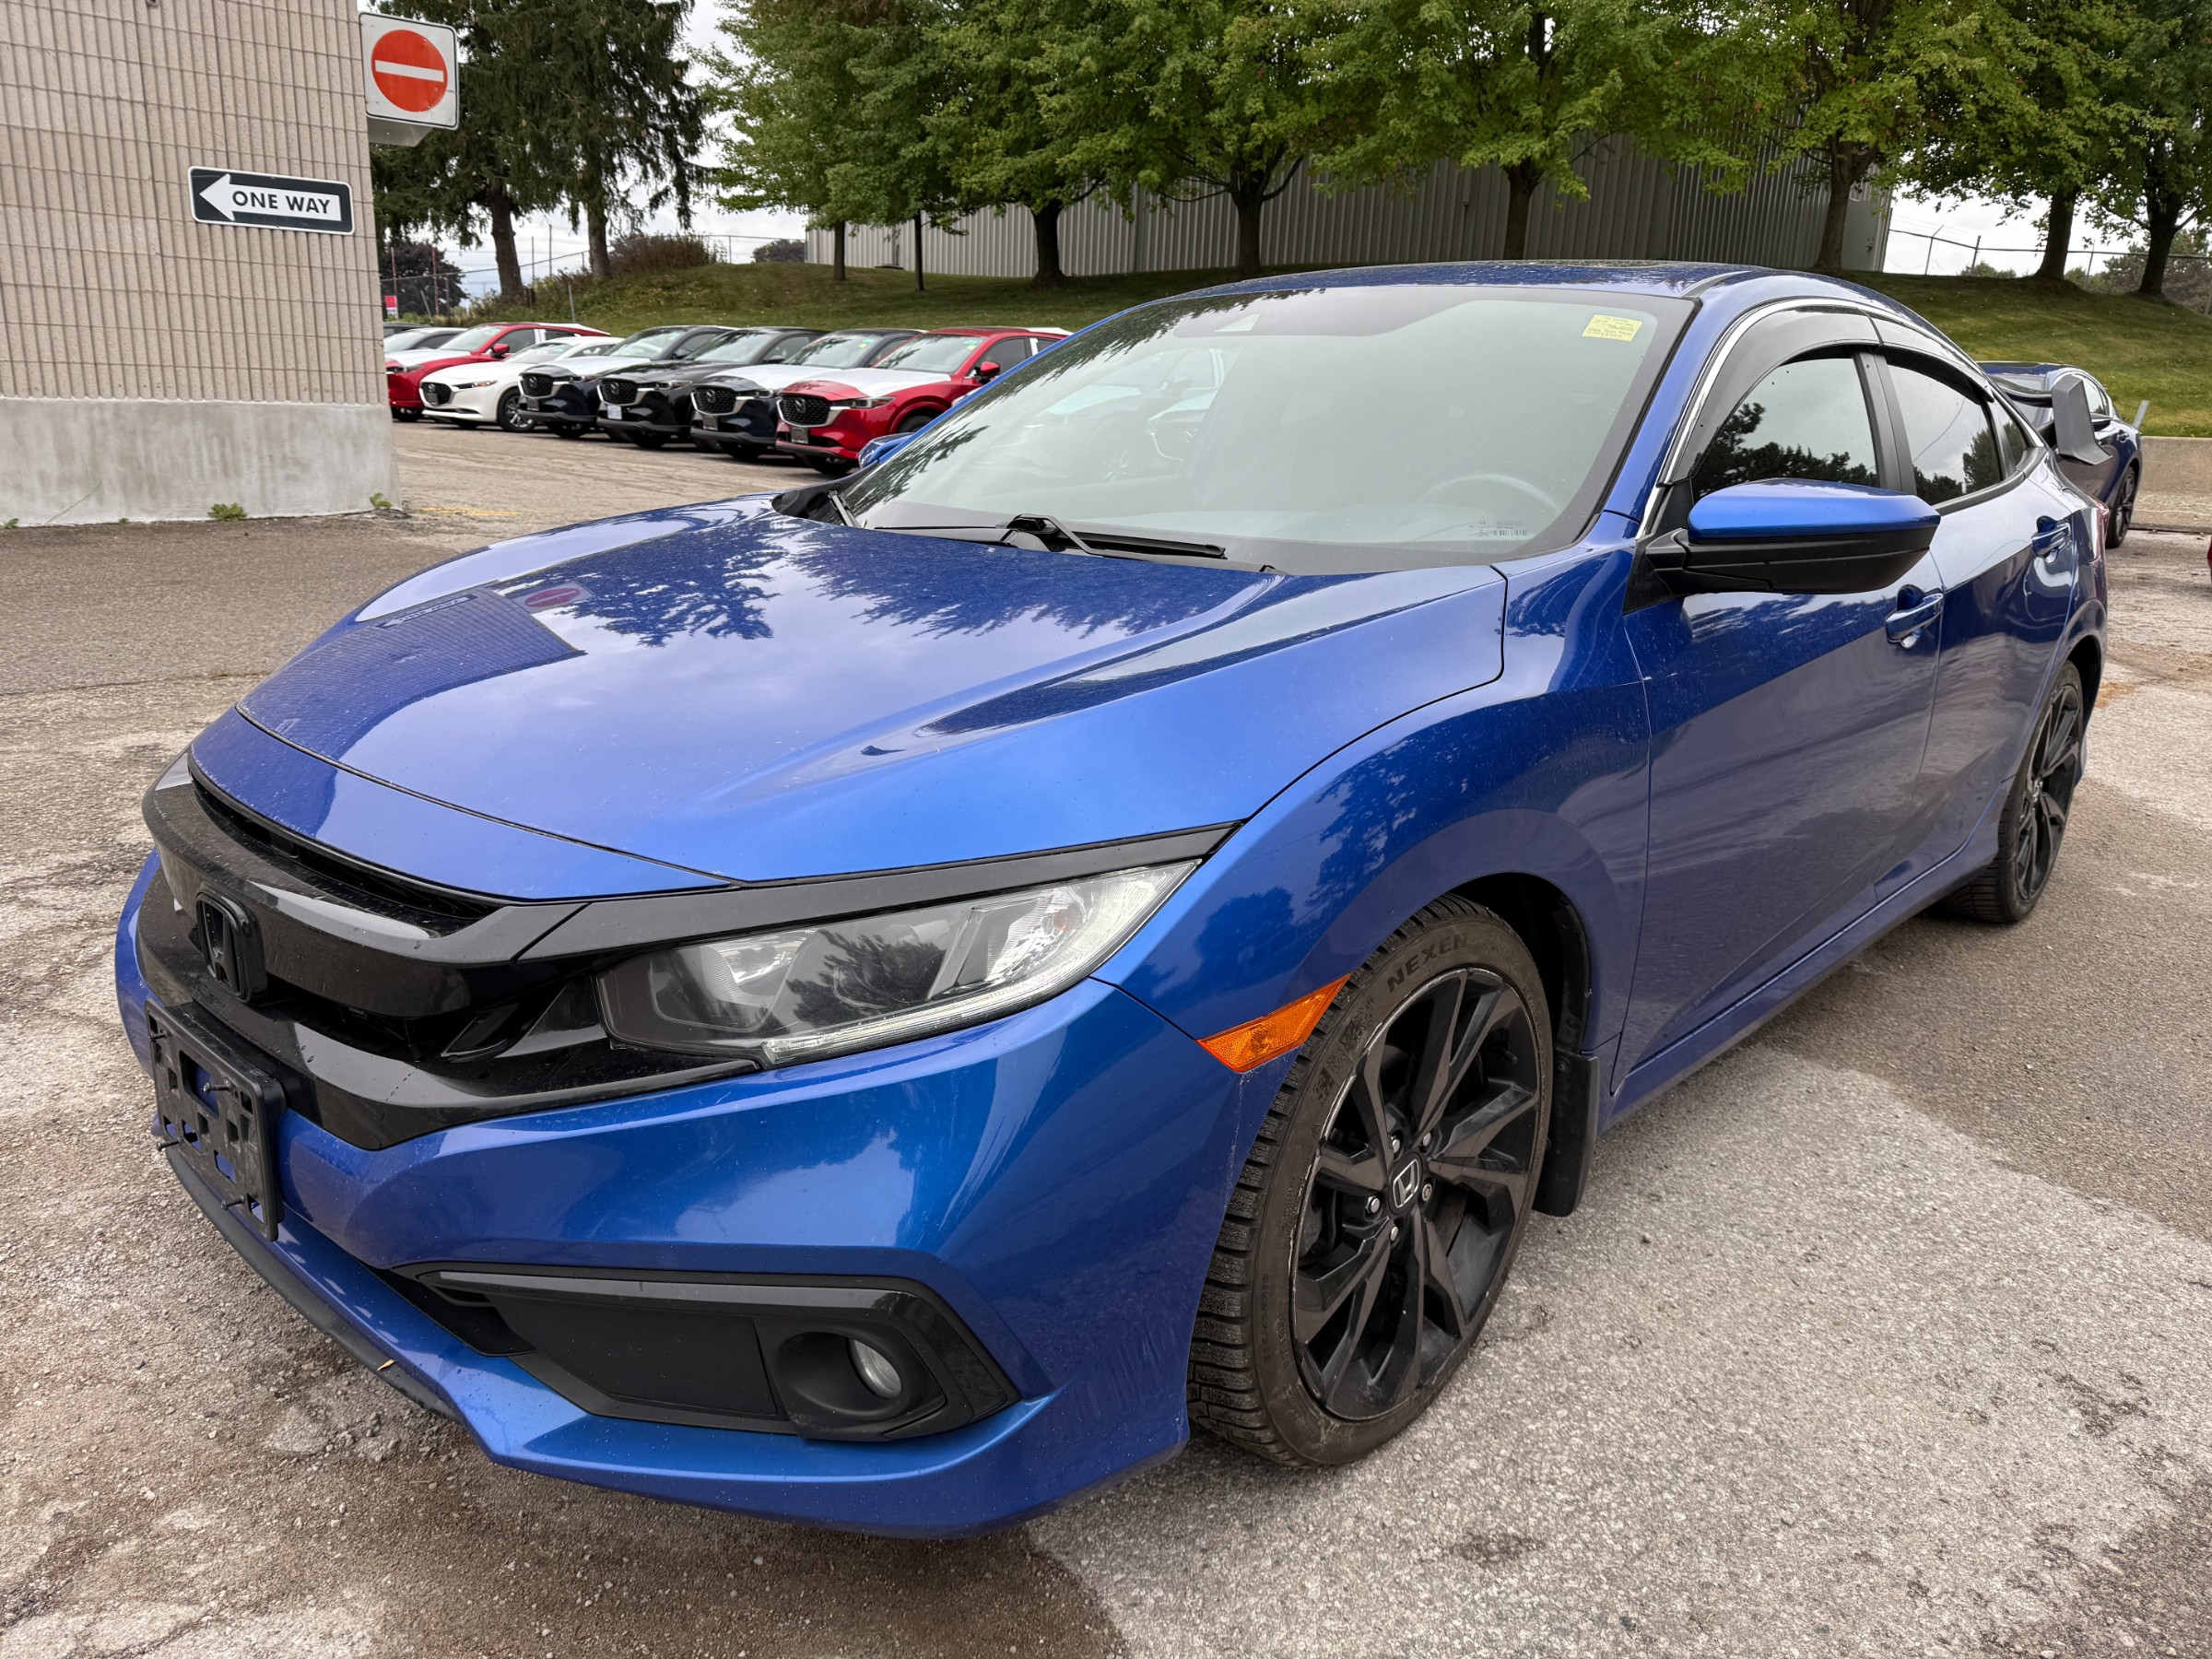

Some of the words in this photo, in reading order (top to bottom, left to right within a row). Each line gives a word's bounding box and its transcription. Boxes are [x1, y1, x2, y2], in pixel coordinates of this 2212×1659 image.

[232, 190, 278, 209] ONE
[285, 194, 330, 214] WAY
[1386, 933, 1468, 994] NEXEN
